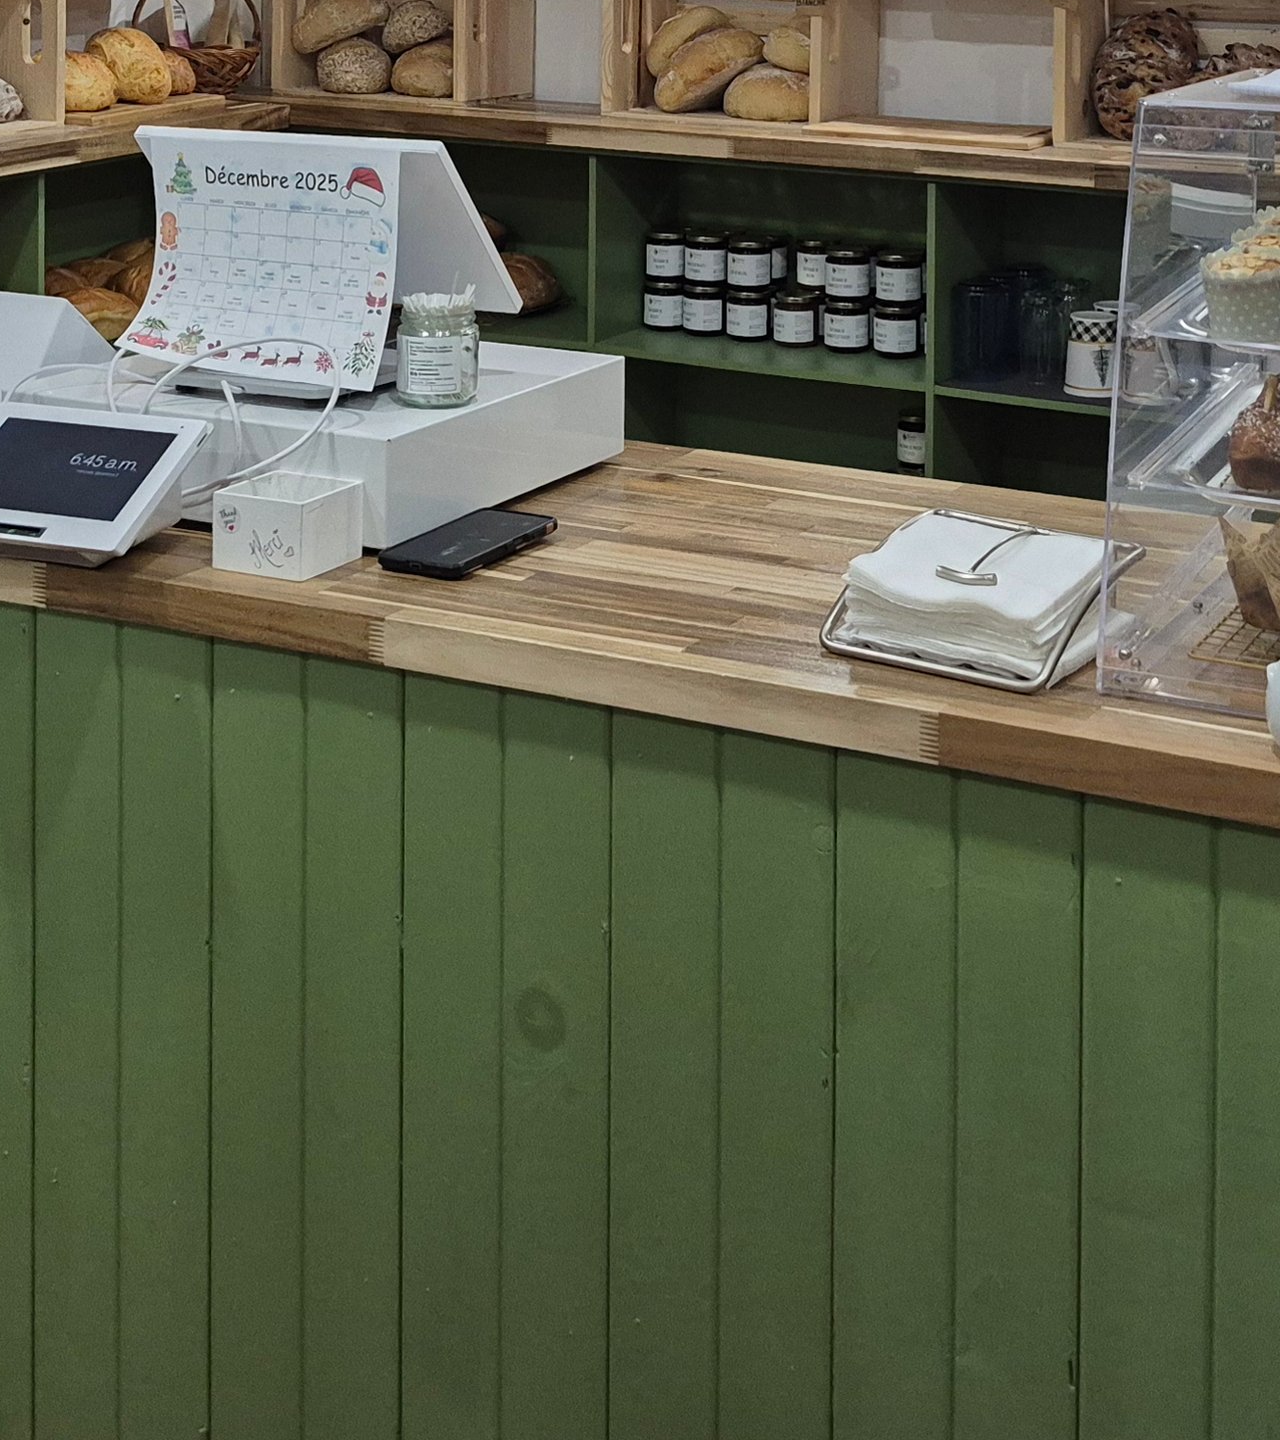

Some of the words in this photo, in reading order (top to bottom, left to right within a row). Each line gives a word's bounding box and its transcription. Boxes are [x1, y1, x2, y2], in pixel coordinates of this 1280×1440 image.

[204, 165, 290, 189] Décembre
[294, 171, 339, 193] 2025
[69, 452, 107, 468] 6:45
[104, 458, 137, 472] a.m.
[249, 528, 284, 569] Merci
